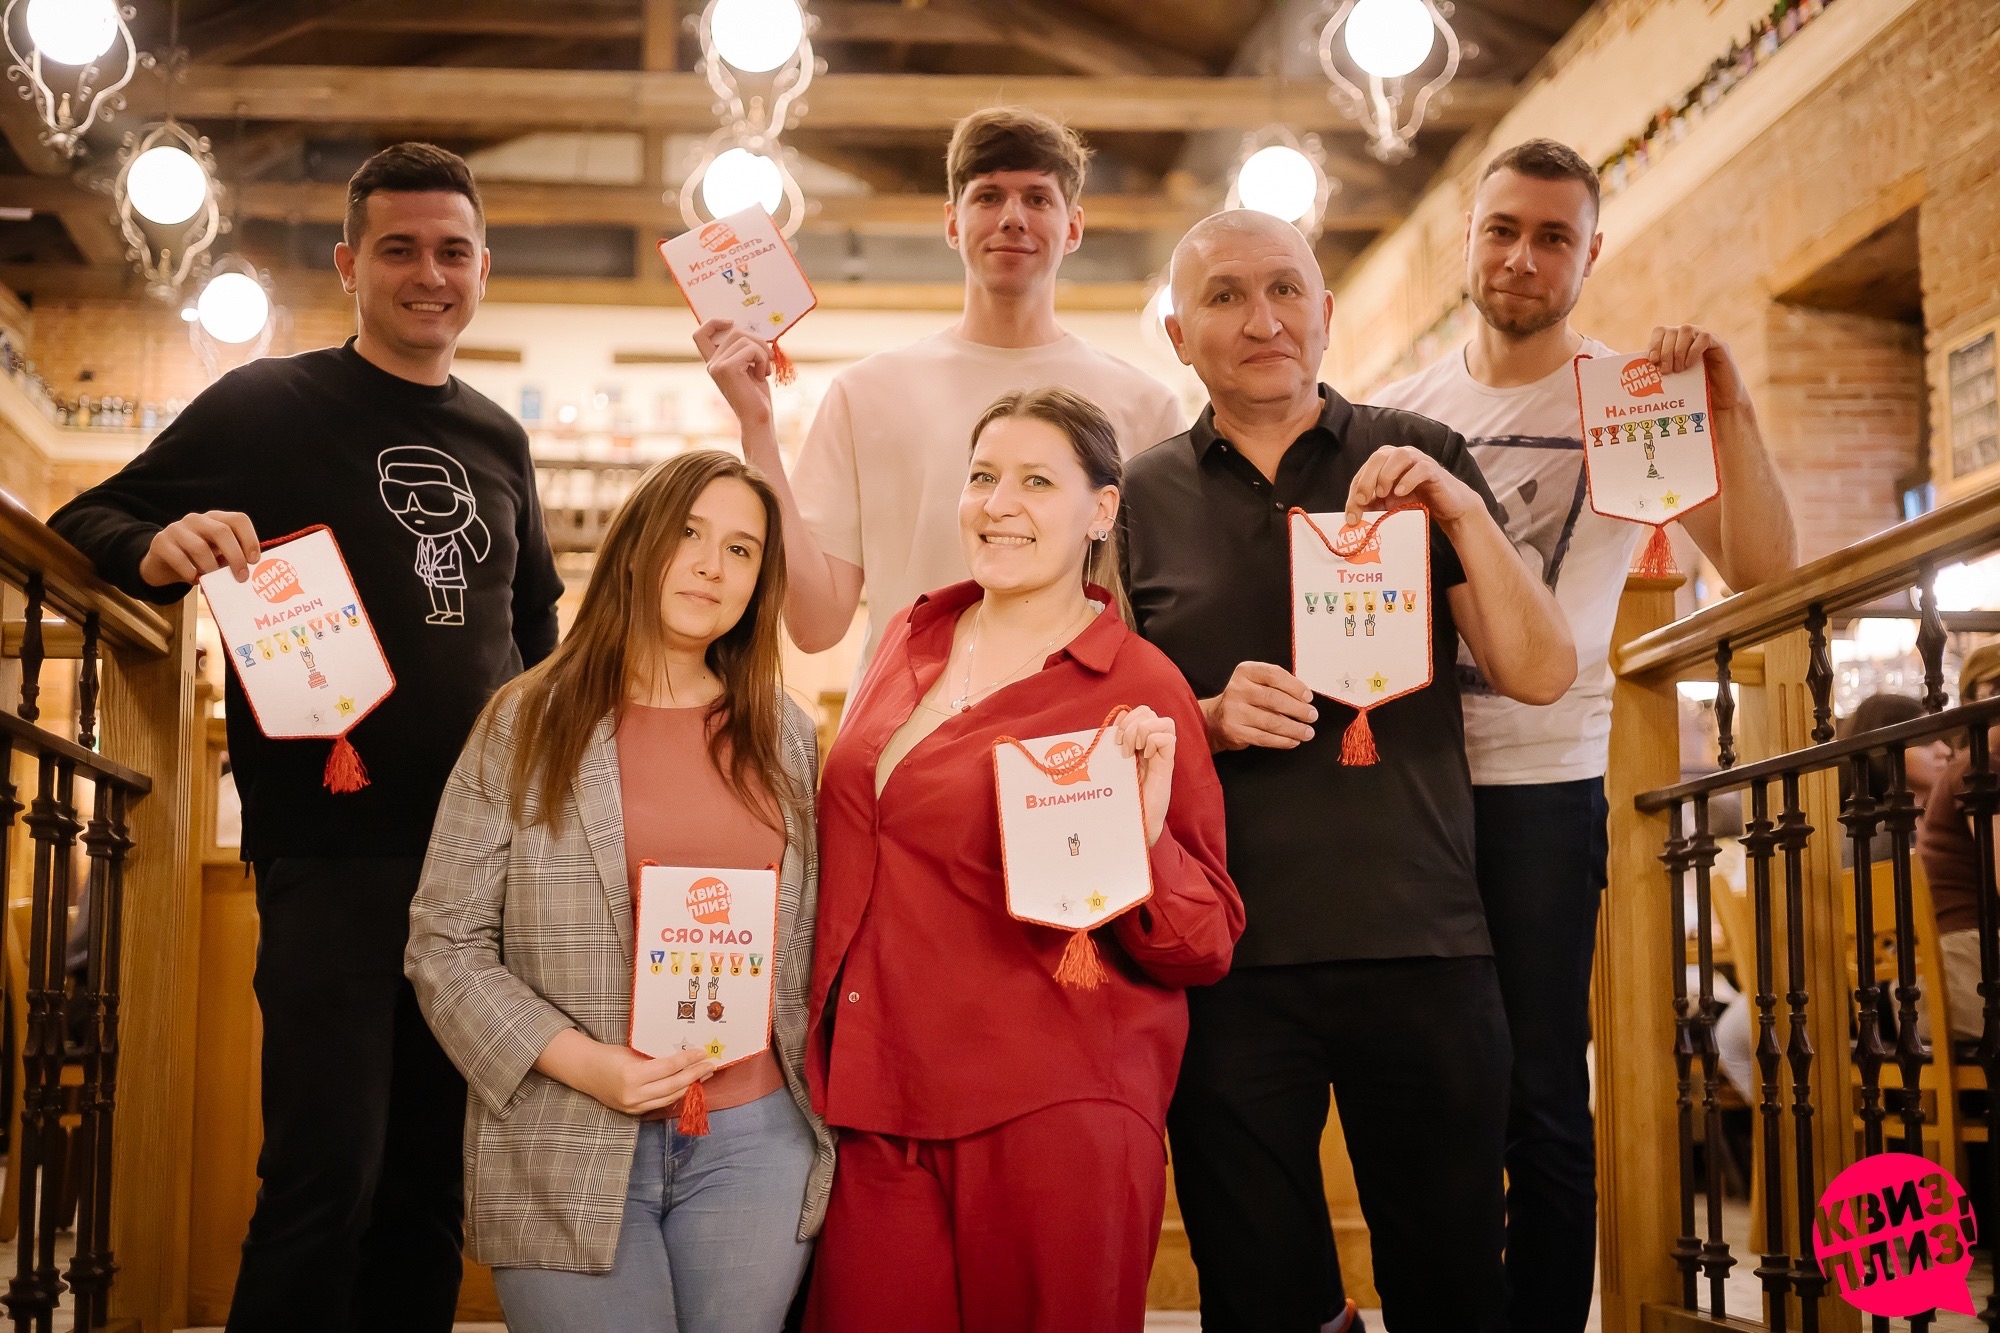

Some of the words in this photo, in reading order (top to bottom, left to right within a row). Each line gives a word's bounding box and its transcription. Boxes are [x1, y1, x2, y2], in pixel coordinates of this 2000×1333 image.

[1667, 496, 1675, 504] 10
[1344, 680, 1350, 688] 5
[1373, 679, 1382, 688] 10
[313, 713, 320, 722] 5
[340, 701, 350, 710] 10
[1062, 902, 1068, 911] 5
[1093, 898, 1101, 907] 10
[709, 929, 753, 946] МАО
[710, 1045, 719, 1054] 10
